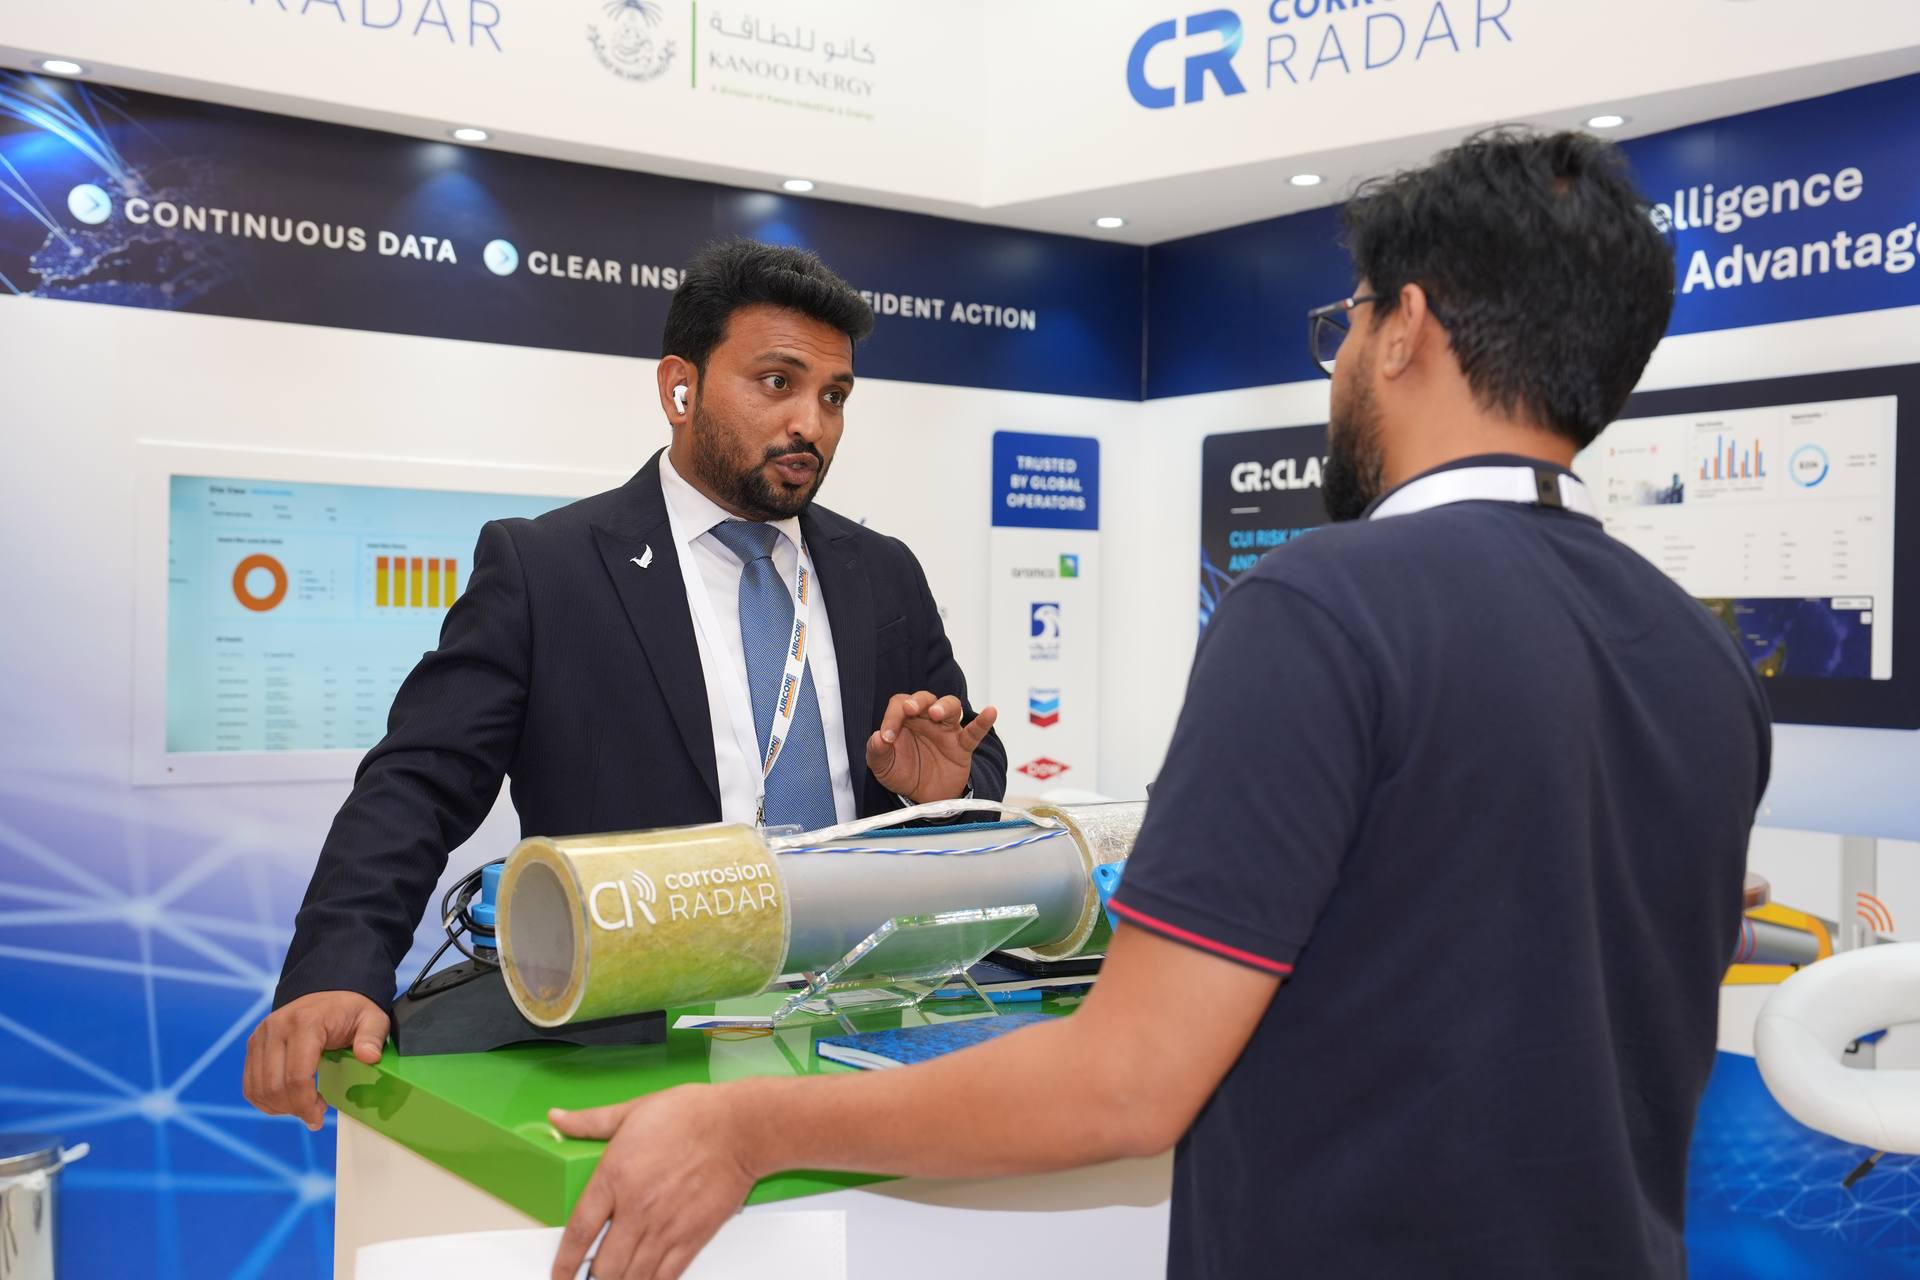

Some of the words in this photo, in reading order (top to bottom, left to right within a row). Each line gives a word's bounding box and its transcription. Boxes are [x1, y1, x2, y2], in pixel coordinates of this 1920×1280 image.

[1126, 9, 1247, 109] CR
[1266, 0, 1512, 89] RADAR
[708, 50, 790, 81] KANOO
[794, 66, 875, 97] ENERGY
[1648, 167, 1863, 233] elligence
[124, 198, 367, 252] CONTINUOUS
[378, 230, 457, 264] DATA
[527, 250, 622, 284] CLEAR
[1682, 222, 1920, 294] Advantag
[858, 290, 945, 320] FIDENT
[951, 302, 1036, 331] ACTION
[1010, 474, 1029, 489] BY
[1029, 475, 1083, 493] GLOBAL
[1016, 455, 1078, 473] TRUSTED
[1006, 493, 1086, 511] OPERATORS
[665, 861, 772, 890] corrosion
[668, 883, 778, 921] RADAR
